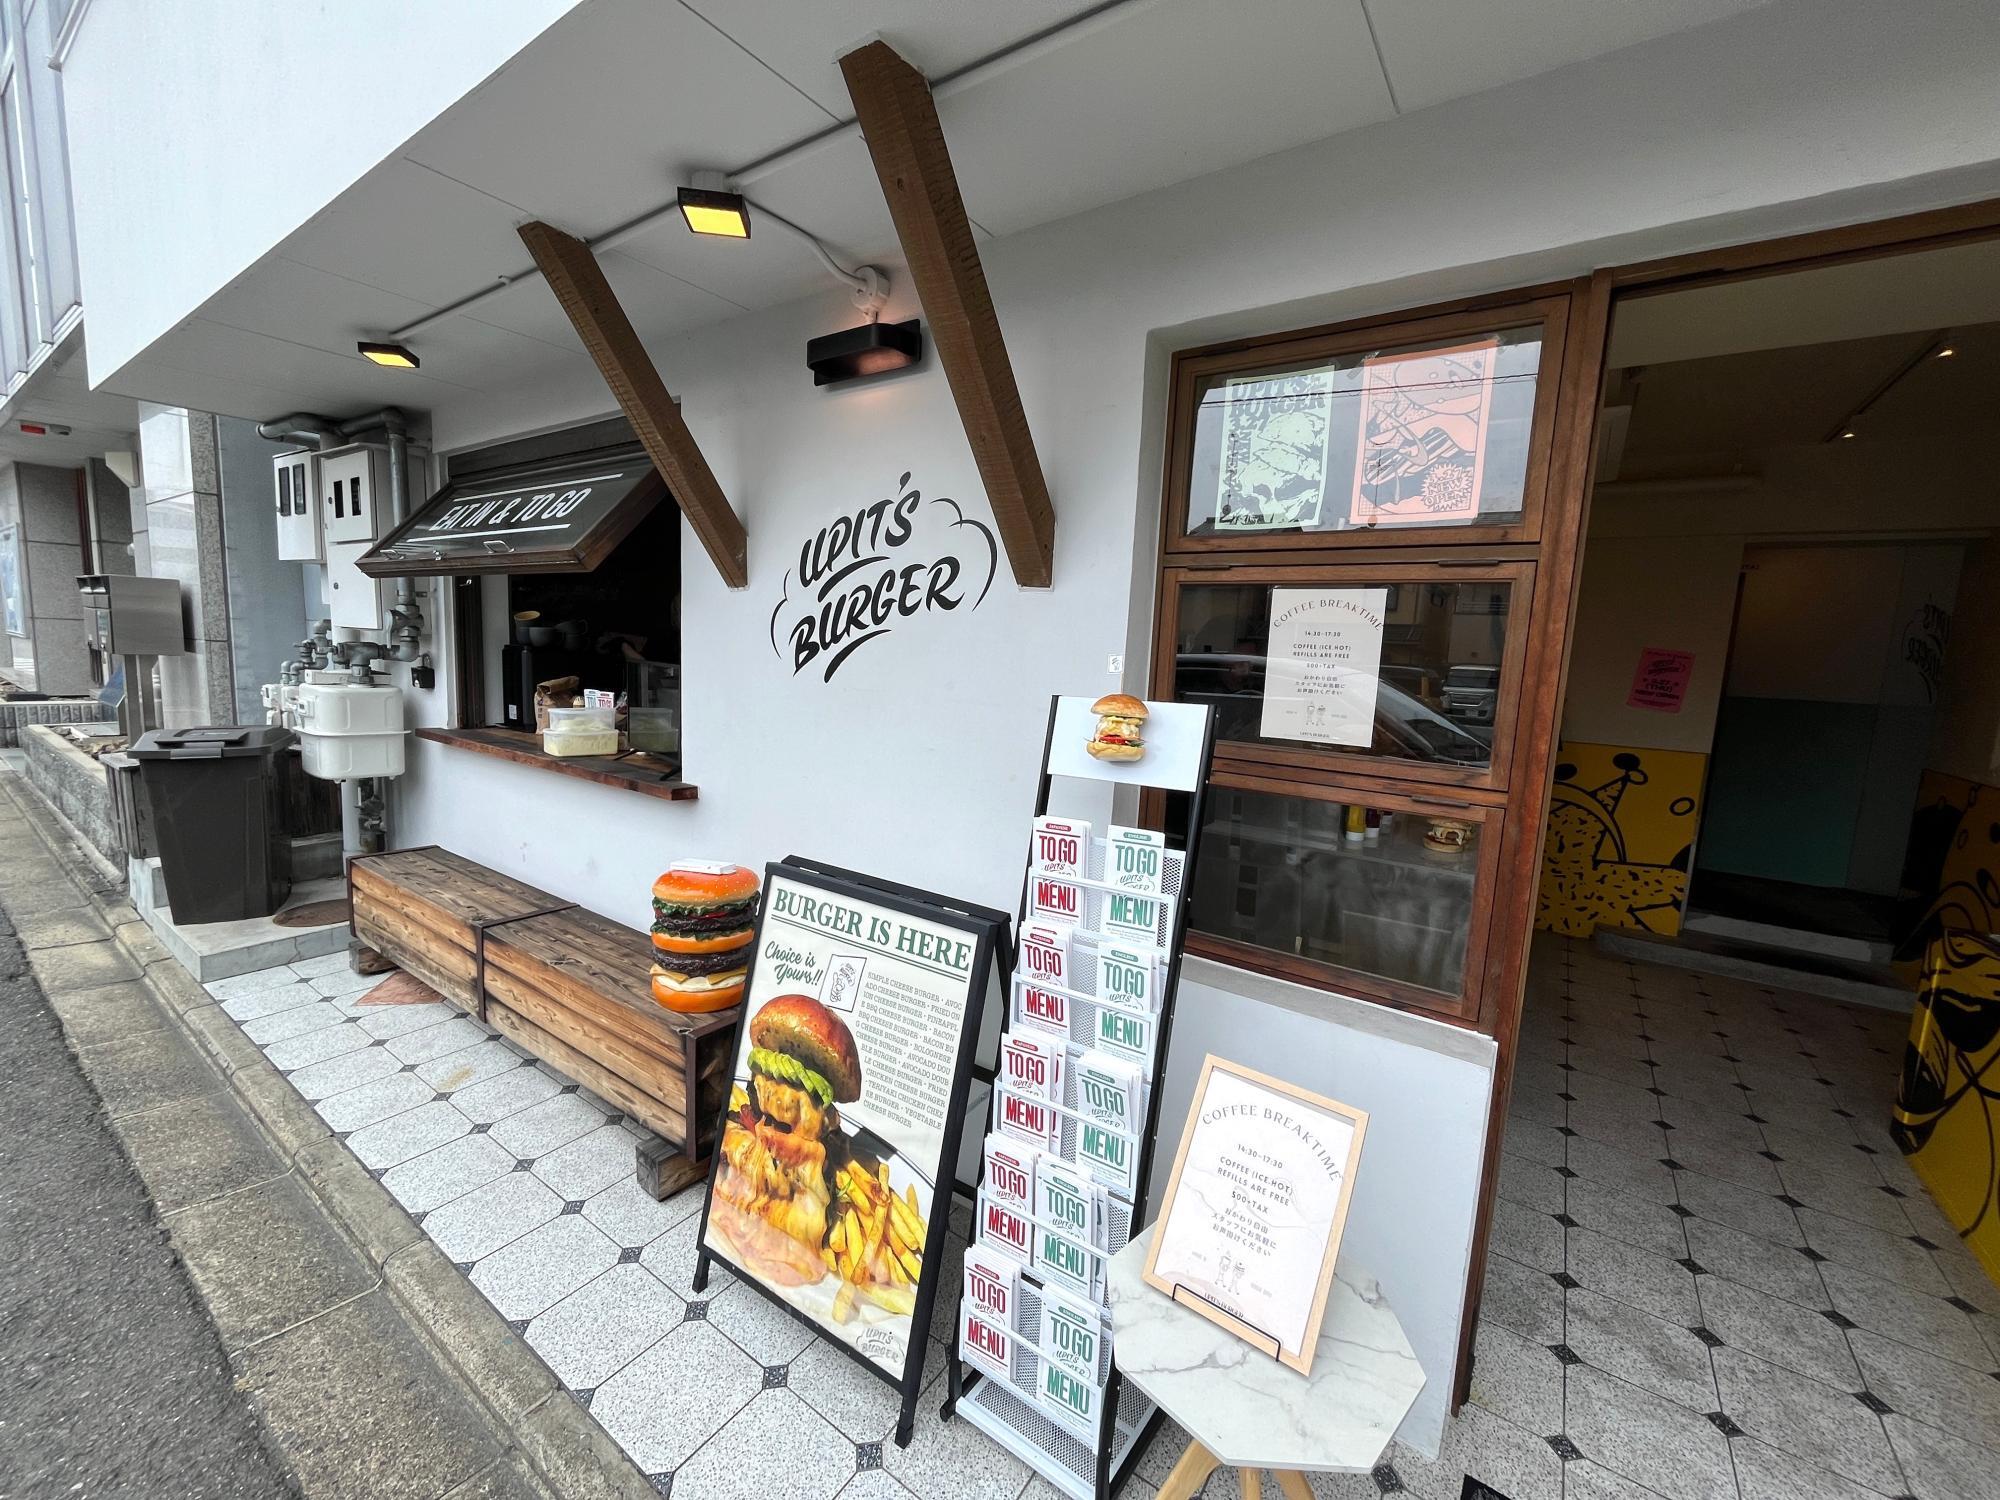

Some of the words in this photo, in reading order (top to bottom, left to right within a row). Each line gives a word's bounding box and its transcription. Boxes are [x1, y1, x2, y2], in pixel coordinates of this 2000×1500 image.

[429, 503, 481, 531] EAT
[461, 499, 503, 527] IN
[489, 497, 522, 525] &
[510, 492, 556, 524] TO
[541, 487, 593, 519] GO
[800, 471, 921, 588] UPIT'S
[788, 555, 966, 677] BURGER
[1273, 600, 1316, 629] COFFEE
[1293, 643, 1317, 651] COFFEE
[1319, 651, 1332, 659] ARE
[1039, 835, 1057, 862] TO
[1058, 838, 1078, 865] GO
[1115, 845, 1135, 873] TO
[1136, 847, 1158, 877] GO
[1037, 881, 1076, 913] MENU
[1109, 894, 1154, 928] MENU
[772, 887, 864, 938] BURGER
[867, 916, 892, 946] IS
[895, 925, 972, 972] HERE
[764, 940, 804, 965] Choice
[803, 951, 817, 969] is
[1024, 944, 1042, 972] TO
[1043, 950, 1062, 977] GO
[774, 963, 824, 986] Yours!!
[867, 971, 890, 985] SIMPLE
[889, 979, 914, 993] CHEESE
[914, 987, 940, 1003] BURGER
[944, 998, 962, 1010] AVOC
[1103, 962, 1122, 993] TO
[1123, 967, 1145, 999] GO
[865, 982, 878, 991] ADO
[877, 985, 900, 1000] CHEESE
[900, 993, 926, 1009] BURGER
[930, 1004, 950, 1018] FRIED
[873, 995, 897, 1009] CHEESE
[897, 1003, 923, 1019] BURGER
[1026, 989, 1064, 1022] MENU
[870, 1015, 894, 1029] CHEESE
[893, 1024, 919, 1040] BURGER
[878, 1007, 902, 1021] CHEESE
[902, 1016, 928, 1032] BURGER
[1102, 1011, 1144, 1049] MENU
[855, 1030, 879, 1045] CHEESE
[907, 1052, 937, 1070] AVOCADO
[860, 1022, 884, 1037] CHEESE
[884, 1031, 909, 1047] BURGER
[913, 1043, 951, 1064] BOLOGNESE
[872, 1060, 896, 1075] CHEESE
[928, 1082, 948, 1097] FRIED
[873, 1049, 897, 1065] BURGER
[901, 1061, 931, 1079] AVOCADO
[1006, 1050, 1024, 1078] TO
[1025, 1056, 1045, 1086] GO
[874, 1094, 900, 1111] BURGER
[893, 1079, 918, 1096] CHEESE
[919, 1091, 946, 1108] BURGER
[1082, 1079, 1102, 1107] TO
[1103, 1087, 1125, 1117] GO
[863, 1099, 887, 1115] CHEESE
[887, 1110, 912, 1128] BURGER
[1006, 1095, 1044, 1133] MENU
[1202, 1104, 1258, 1126] COFFEE
[1083, 1124, 1125, 1167] MENU
[989, 1161, 1007, 1190] TO
[1008, 1169, 1027, 1200] GO
[1219, 1155, 1250, 1176] COFFEE
[1217, 1166, 1248, 1187] REFILLS
[1249, 1183, 1267, 1196] ARE
[1268, 1190, 1290, 1207] FREE
[1231, 1190, 1269, 1214] 500+TAX
[988, 1205, 1026, 1247] MENU
[1046, 1186, 1064, 1218] TO
[1066, 1197, 1086, 1230] GO
[1044, 1234, 1085, 1278] MENU
[968, 1273, 986, 1303] TO
[987, 1283, 1006, 1314] GO
[861, 1343, 899, 1363] BURGER
[967, 1317, 1005, 1360] MENU
[1050, 1316, 1070, 1350] TO
[1072, 1328, 1093, 1364] GO
[1046, 1365, 1090, 1415] MENU
